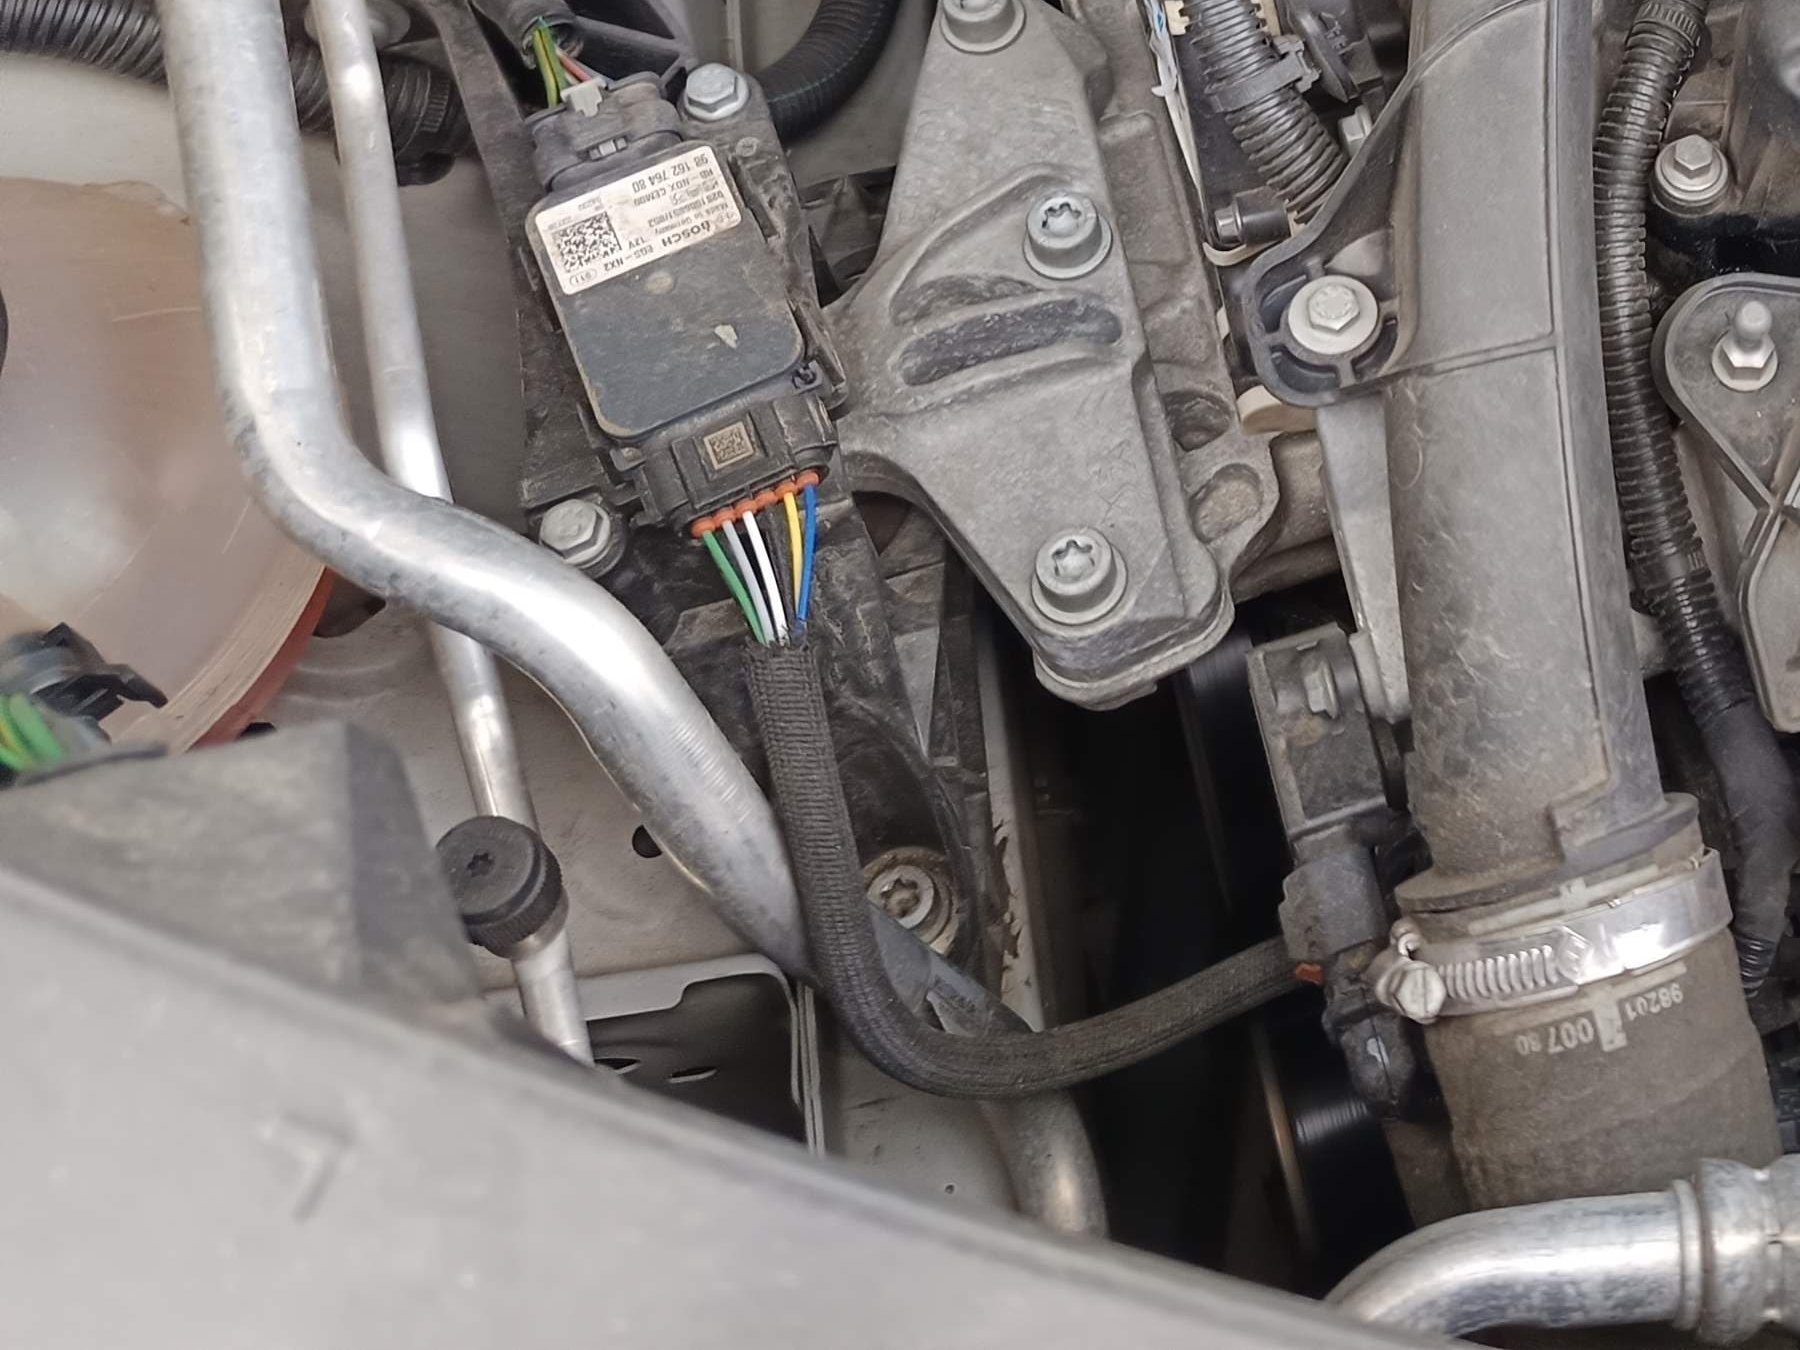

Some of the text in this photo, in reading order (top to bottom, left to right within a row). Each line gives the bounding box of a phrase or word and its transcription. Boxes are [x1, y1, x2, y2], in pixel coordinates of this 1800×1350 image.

[630, 177, 646, 193] 80
[660, 219, 712, 247] BOSCH
[1623, 981, 1685, 1021] 98201
